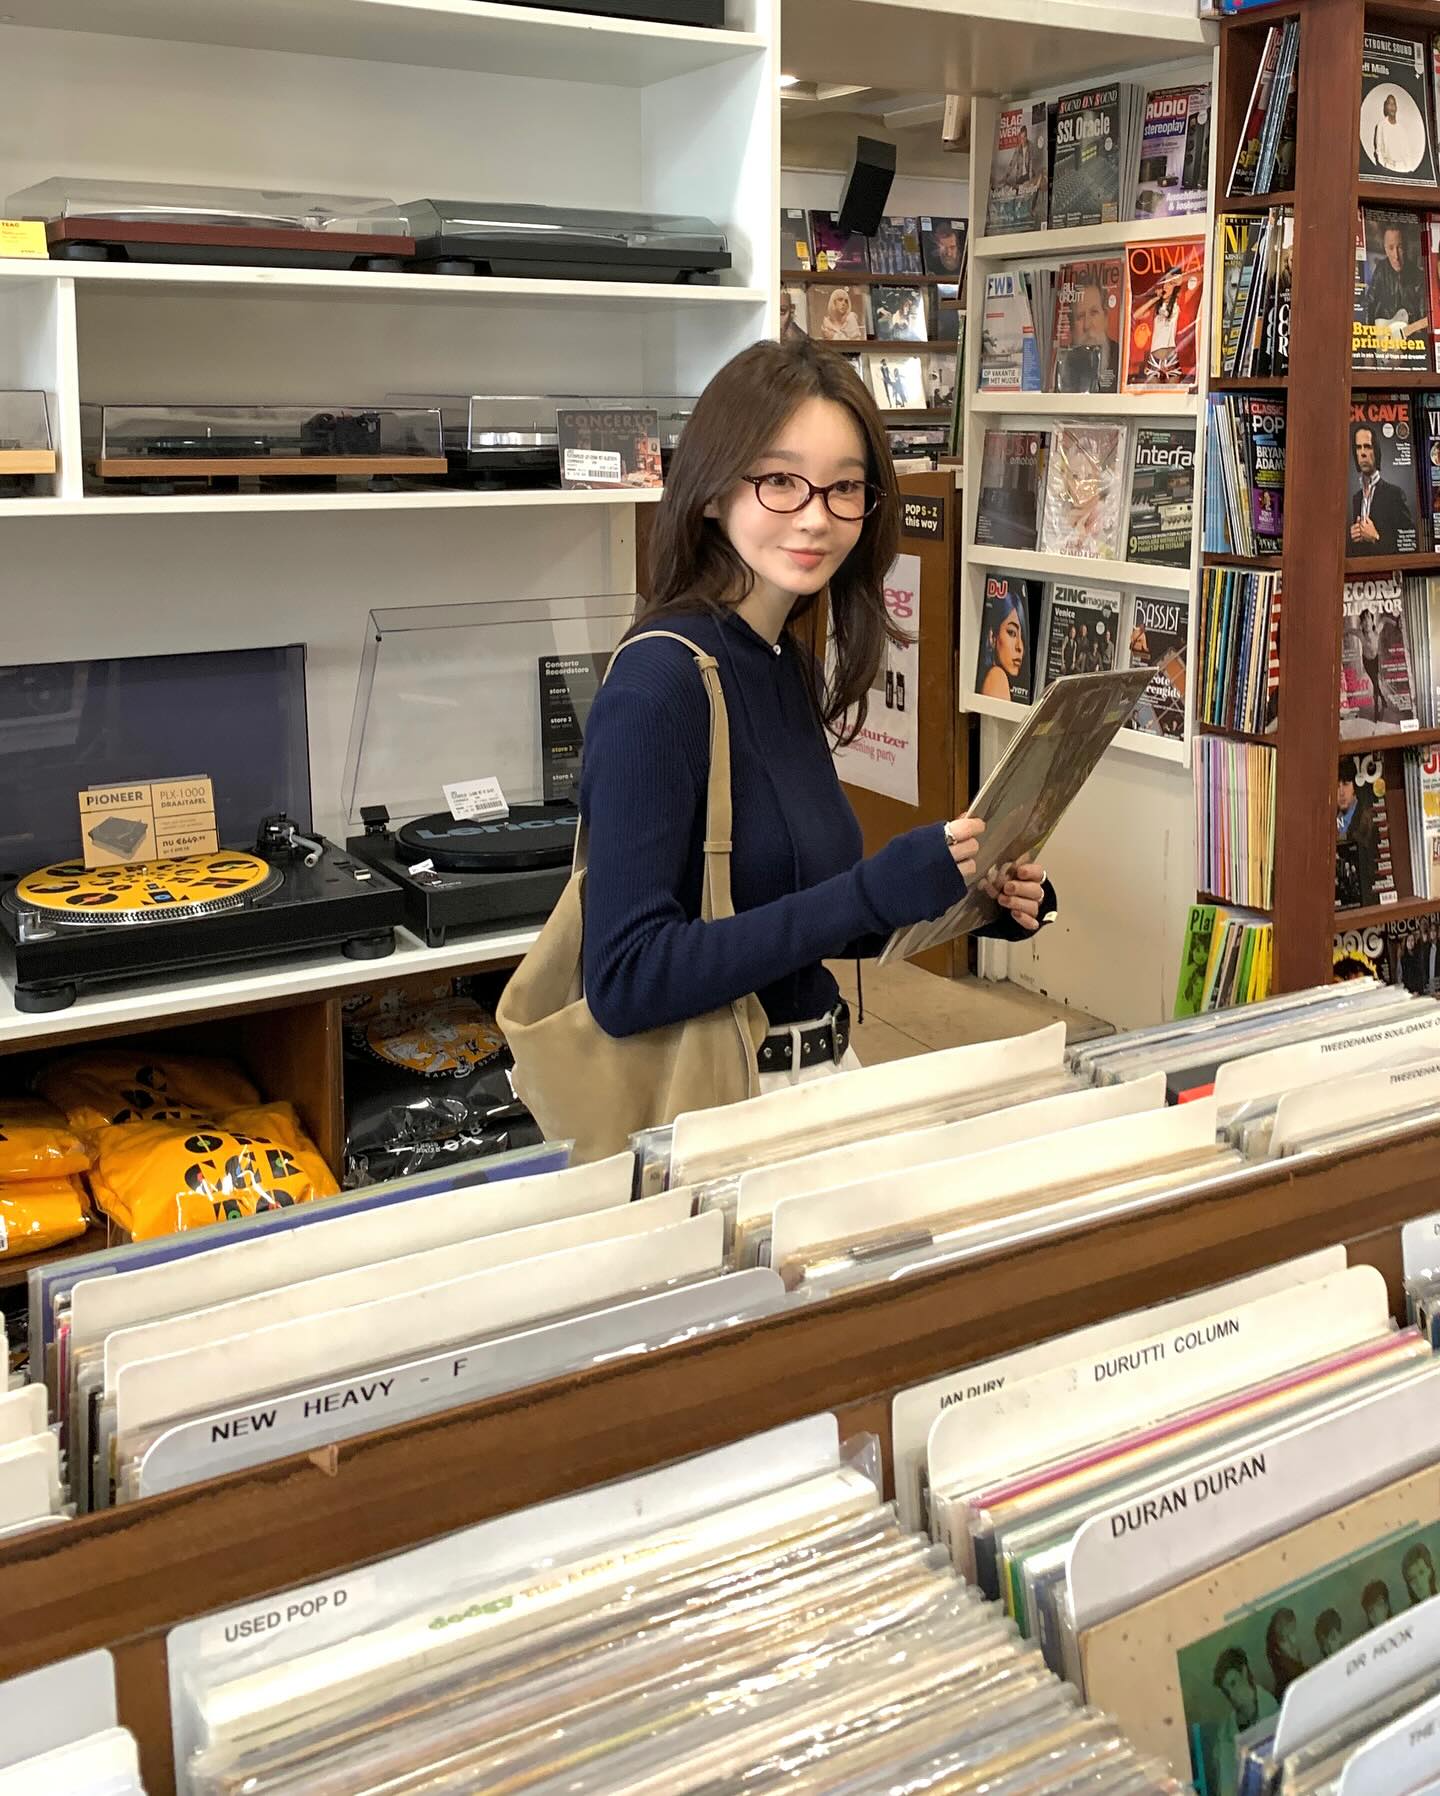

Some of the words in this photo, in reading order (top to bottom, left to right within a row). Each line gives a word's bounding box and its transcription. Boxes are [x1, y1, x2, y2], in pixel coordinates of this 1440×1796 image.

[1392, 42, 1413, 56] SOUND
[1371, 63, 1390, 76] Mills
[1060, 99, 1081, 114] SOUND
[1094, 89, 1118, 106] SOUND
[1145, 98, 1188, 120] AUDIO
[1057, 119, 1075, 144] SSL
[1075, 111, 1110, 141] Oracle
[1144, 119, 1186, 136] stereoplay
[1130, 245, 1202, 275] OLIVIA
[986, 275, 1015, 297] FWD
[1251, 403, 1284, 415] CLASSIC
[1367, 404, 1409, 421] CAVE
[564, 414, 655, 428] CONCERTO
[1252, 414, 1285, 434] POP
[1136, 444, 1193, 469] Interfa
[1255, 445, 1285, 459] BRYAN
[905, 503, 920, 515] POP
[921, 505, 926, 516] S
[932, 506, 938, 518] Z
[905, 515, 920, 528] this
[920, 519, 938, 532] way
[1130, 535, 1137, 554] 9
[987, 577, 1009, 598] DJ
[1054, 586, 1087, 604] ZING
[1343, 579, 1402, 603] ECORD
[883, 587, 914, 618] eg
[1054, 607, 1076, 619] Venice
[545, 660, 579, 669] Concerto
[545, 667, 589, 676] Recordstore
[86, 790, 143, 806] PIONEER
[160, 786, 205, 800] PLX-1000
[161, 797, 207, 808] DRAAITAFEL
[1093, 1342, 1166, 1382] DURUTTI
[1173, 1317, 1241, 1355] COLUMN
[210, 1410, 277, 1443] NEW
[303, 1378, 396, 1418] HEAVY
[453, 1357, 469, 1377] F
[939, 1387, 964, 1410] IAN
[964, 1376, 1007, 1400] DURY
[1110, 1482, 1190, 1540] DURAN
[1193, 1453, 1267, 1505] DURAN
[224, 1610, 282, 1644] USED
[286, 1595, 330, 1625] POP
[332, 1588, 348, 1608] D
